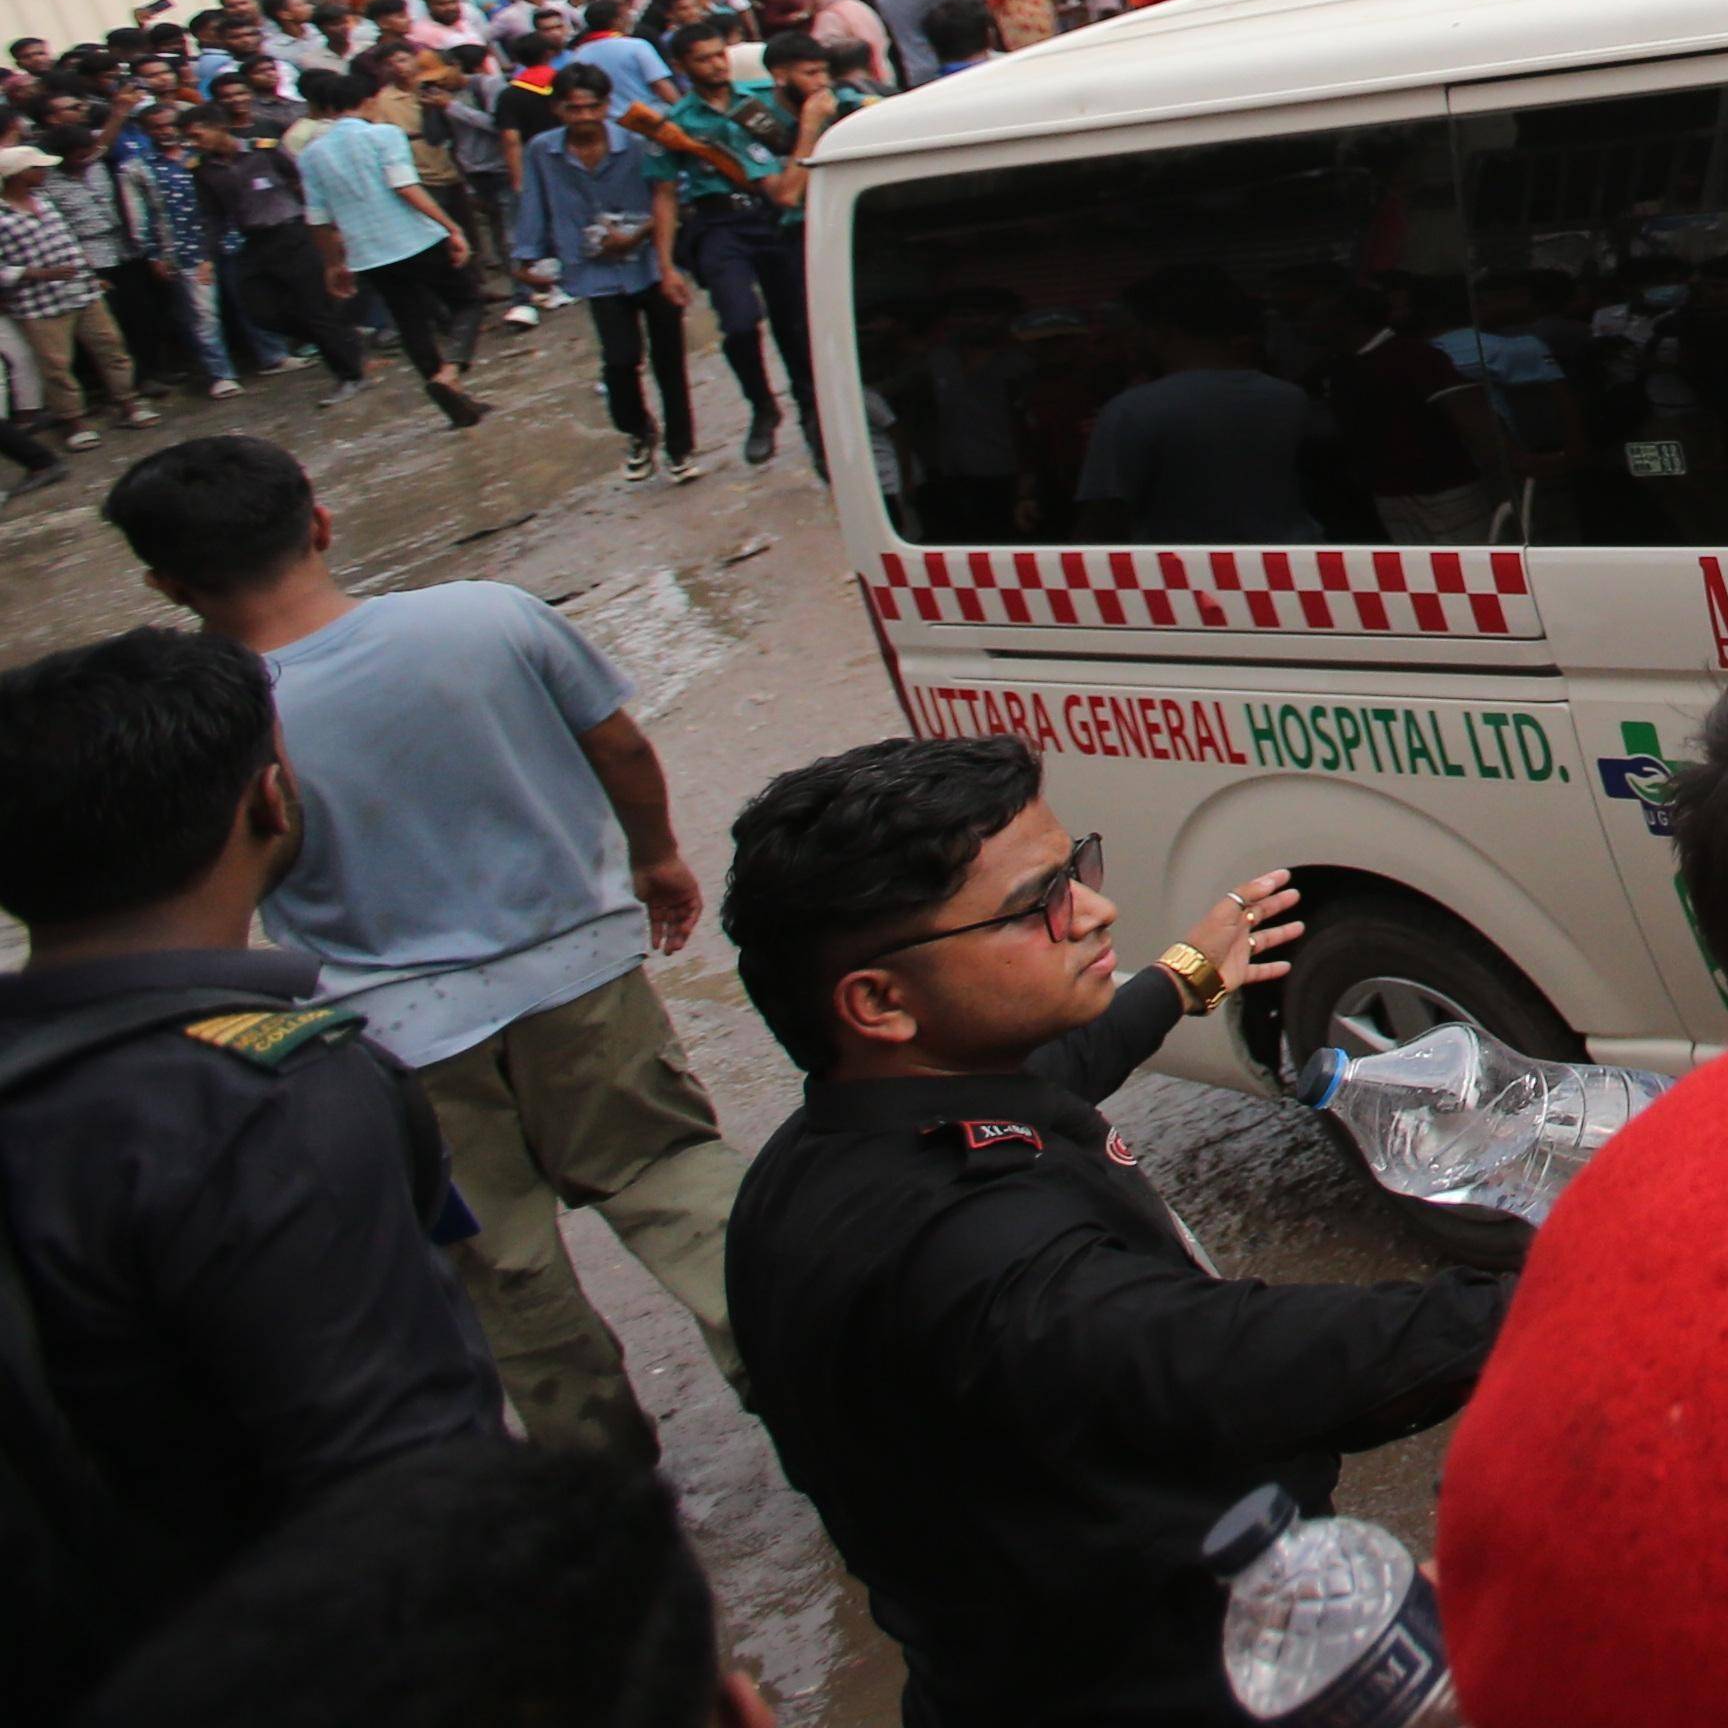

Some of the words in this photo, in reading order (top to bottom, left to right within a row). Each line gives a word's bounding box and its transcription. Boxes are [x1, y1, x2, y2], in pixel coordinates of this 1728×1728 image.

[913, 685, 1063, 753] UTTARA
[1063, 693, 1246, 766] GENERAL
[1245, 703, 1465, 778] HOSPITAL
[1464, 711, 1570, 784] LTD.
[1648, 809, 1669, 828] UG
